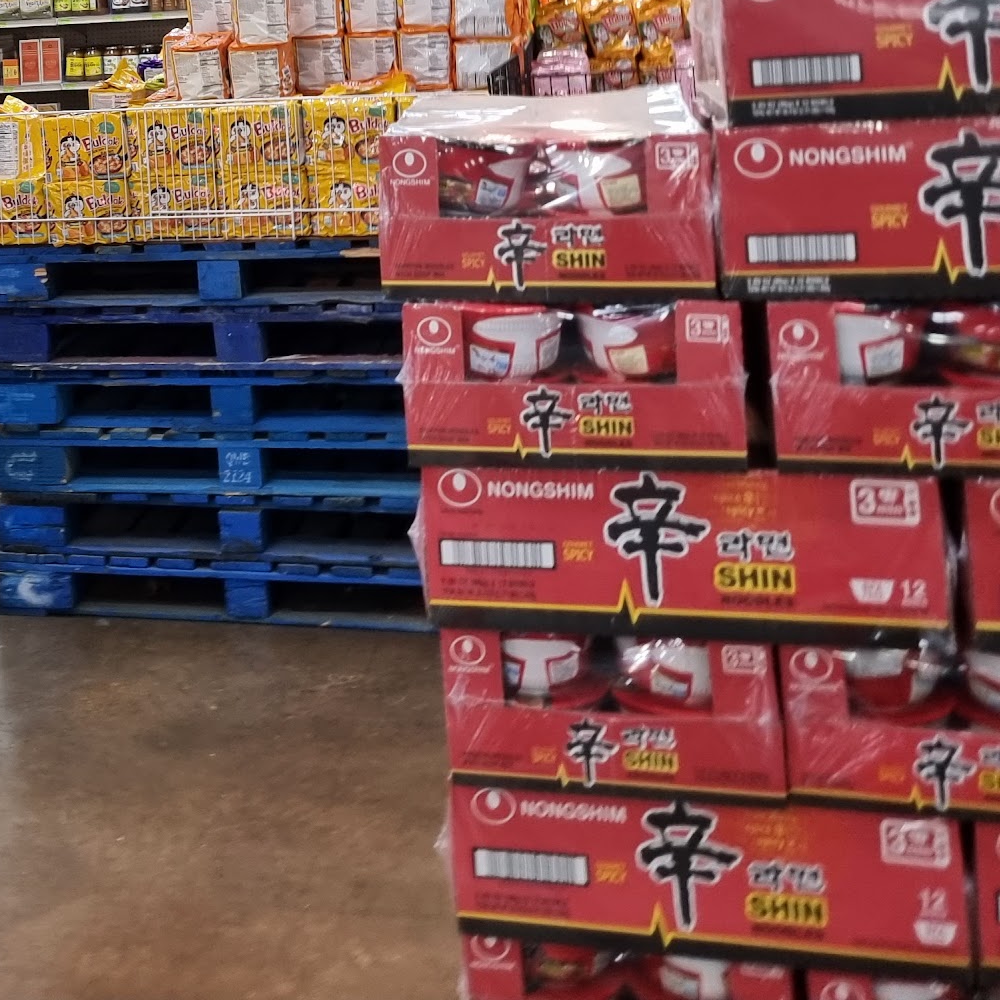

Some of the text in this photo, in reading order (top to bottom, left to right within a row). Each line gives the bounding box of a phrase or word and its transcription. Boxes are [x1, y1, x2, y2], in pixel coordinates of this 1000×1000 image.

[81, 135, 120, 151] Buldak
[789, 145, 907, 167] NONGSHIM
[390, 178, 431, 187] NONGSHIM
[2, 194, 38, 209] Buldak
[918, 126, 1000, 279] 辛
[494, 218, 547, 292] 辛
[556, 252, 605, 268] SHIN
[520, 384, 575, 459] 辛
[581, 419, 633, 435] SHIN
[909, 392, 975, 470] 辛
[487, 480, 595, 501] NONGSHIM
[602, 469, 712, 609] 辛
[718, 566, 793, 590] SHIN
[566, 717, 620, 788] 辛
[625, 754, 675, 771] SHIN
[913, 733, 978, 812] 辛
[521, 800, 628, 825] NONGSHIM
[635, 800, 744, 932] 辛
[750, 896, 824, 923] SHIN
